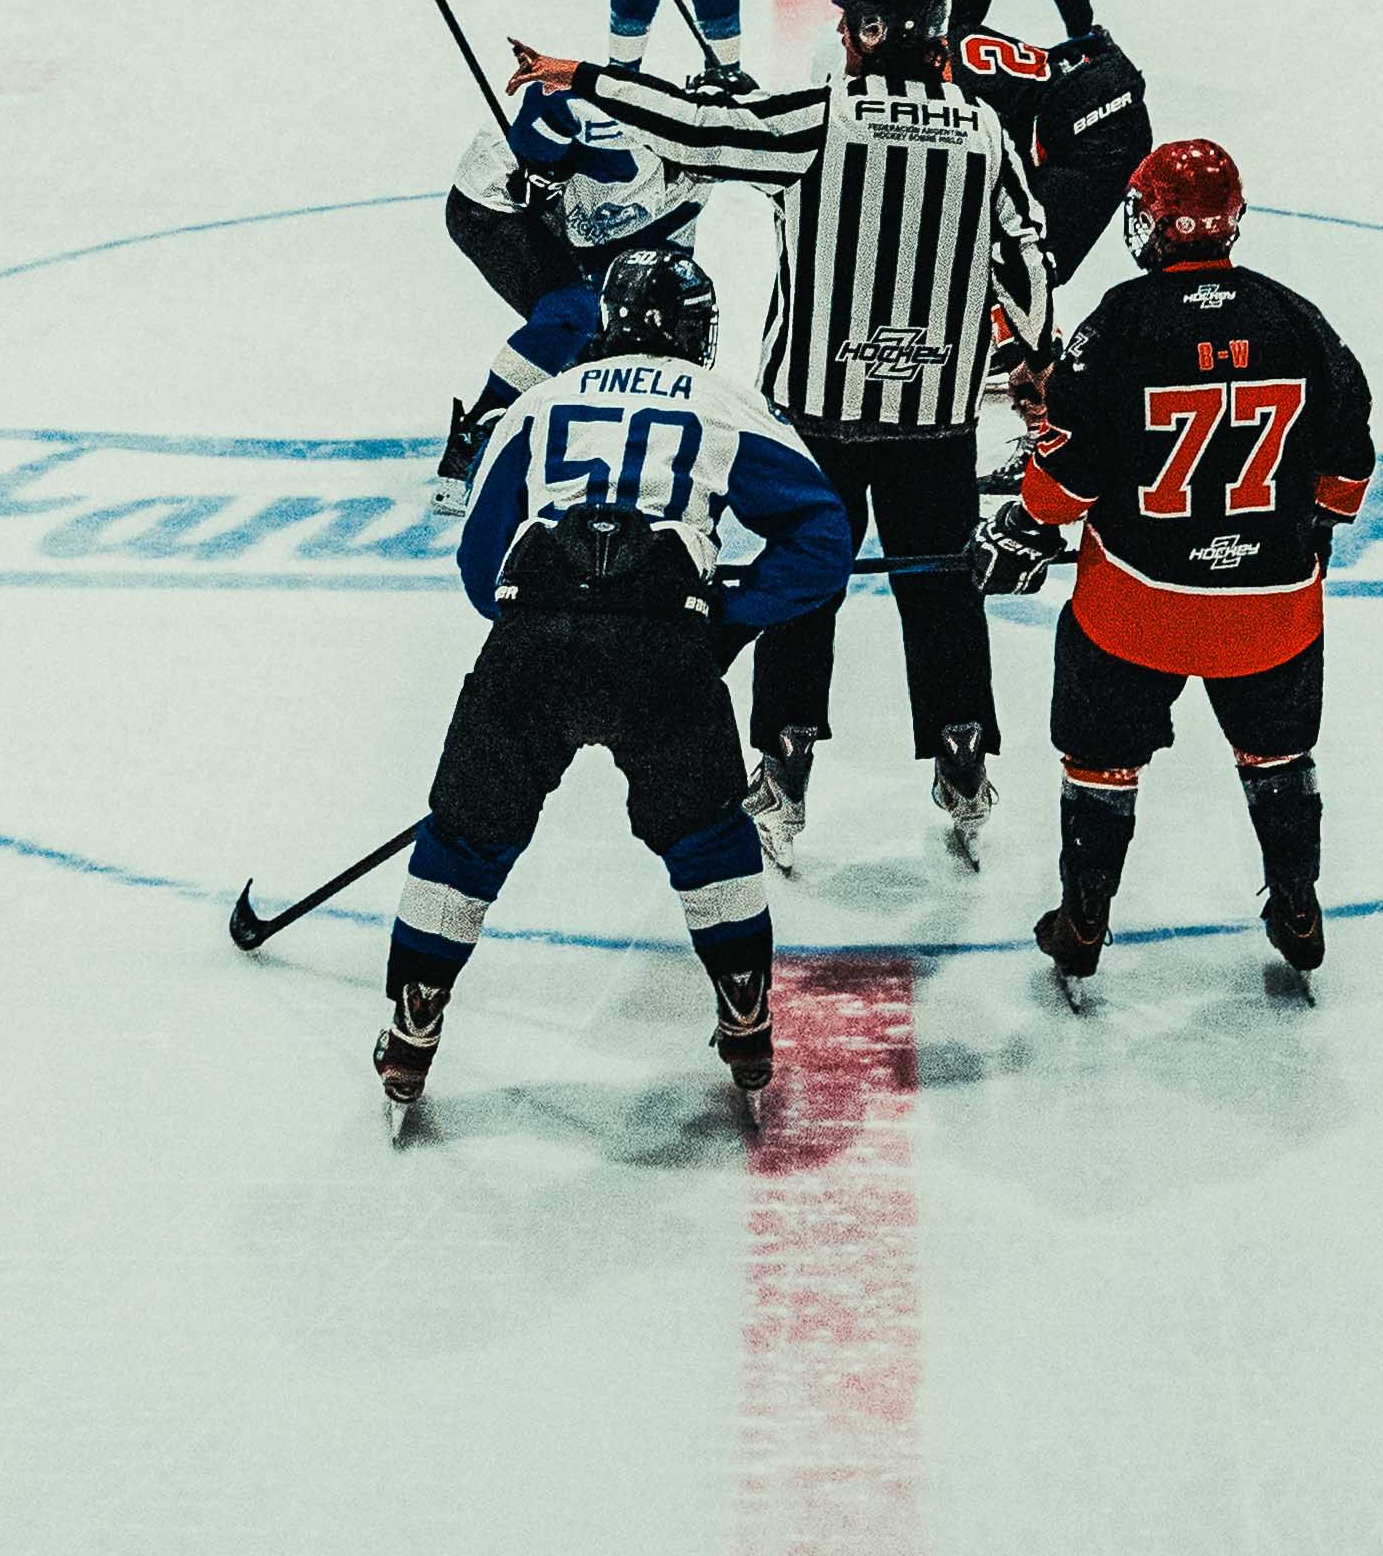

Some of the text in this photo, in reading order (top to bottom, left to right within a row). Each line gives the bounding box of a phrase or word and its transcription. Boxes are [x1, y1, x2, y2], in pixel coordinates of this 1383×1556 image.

[855, 100, 979, 132] FAHH
[579, 368, 693, 400] PINELA
[537, 404, 705, 522] 50
[1138, 379, 1307, 519] 77
